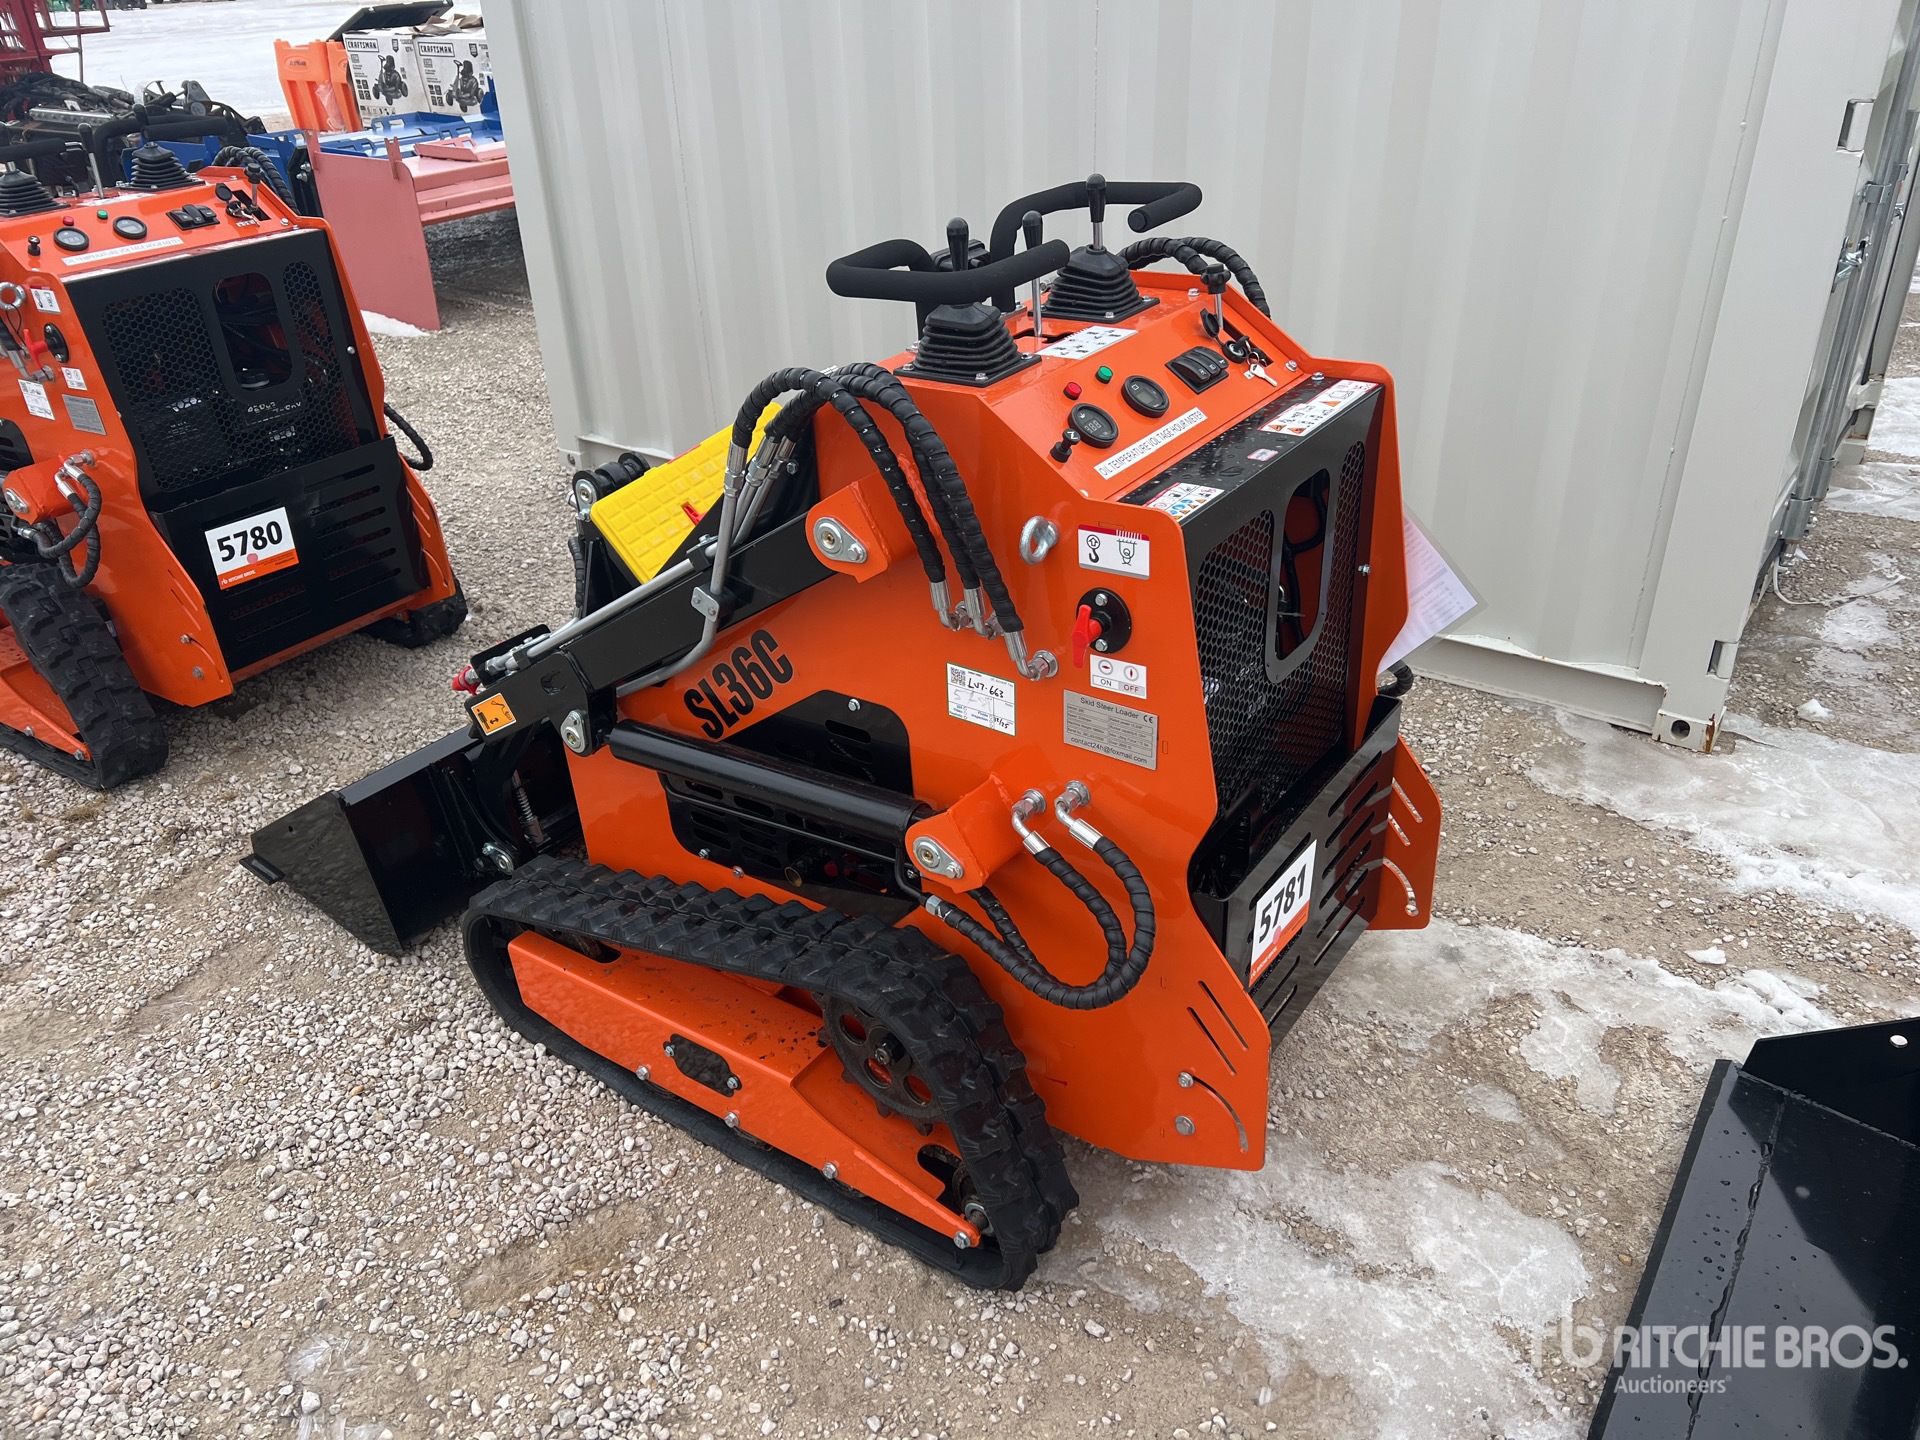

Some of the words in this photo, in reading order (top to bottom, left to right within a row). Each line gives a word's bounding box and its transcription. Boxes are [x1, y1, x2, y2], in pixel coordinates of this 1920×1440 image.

[347, 41, 378, 50] CRAFTSMAN
[420, 45, 453, 55] CRAFTSMAN
[1099, 464, 1112, 476] OIL
[1108, 442, 1149, 469] TEMPERATURE
[1146, 428, 1174, 447] VOLTAGE
[1170, 420, 1188, 433] HOUR
[1185, 411, 1203, 424] METER
[217, 521, 283, 562] 5780
[683, 629, 794, 739] SL36C
[1100, 678, 1112, 687] ON
[1124, 684, 1139, 693] OFF
[1080, 697, 1094, 706] Skid
[1096, 701, 1113, 712] Steer
[1115, 707, 1138, 719] Loader
[1070, 735, 1148, 764] contact24h@foxmail.com
[1258, 863, 1307, 944] 5781
